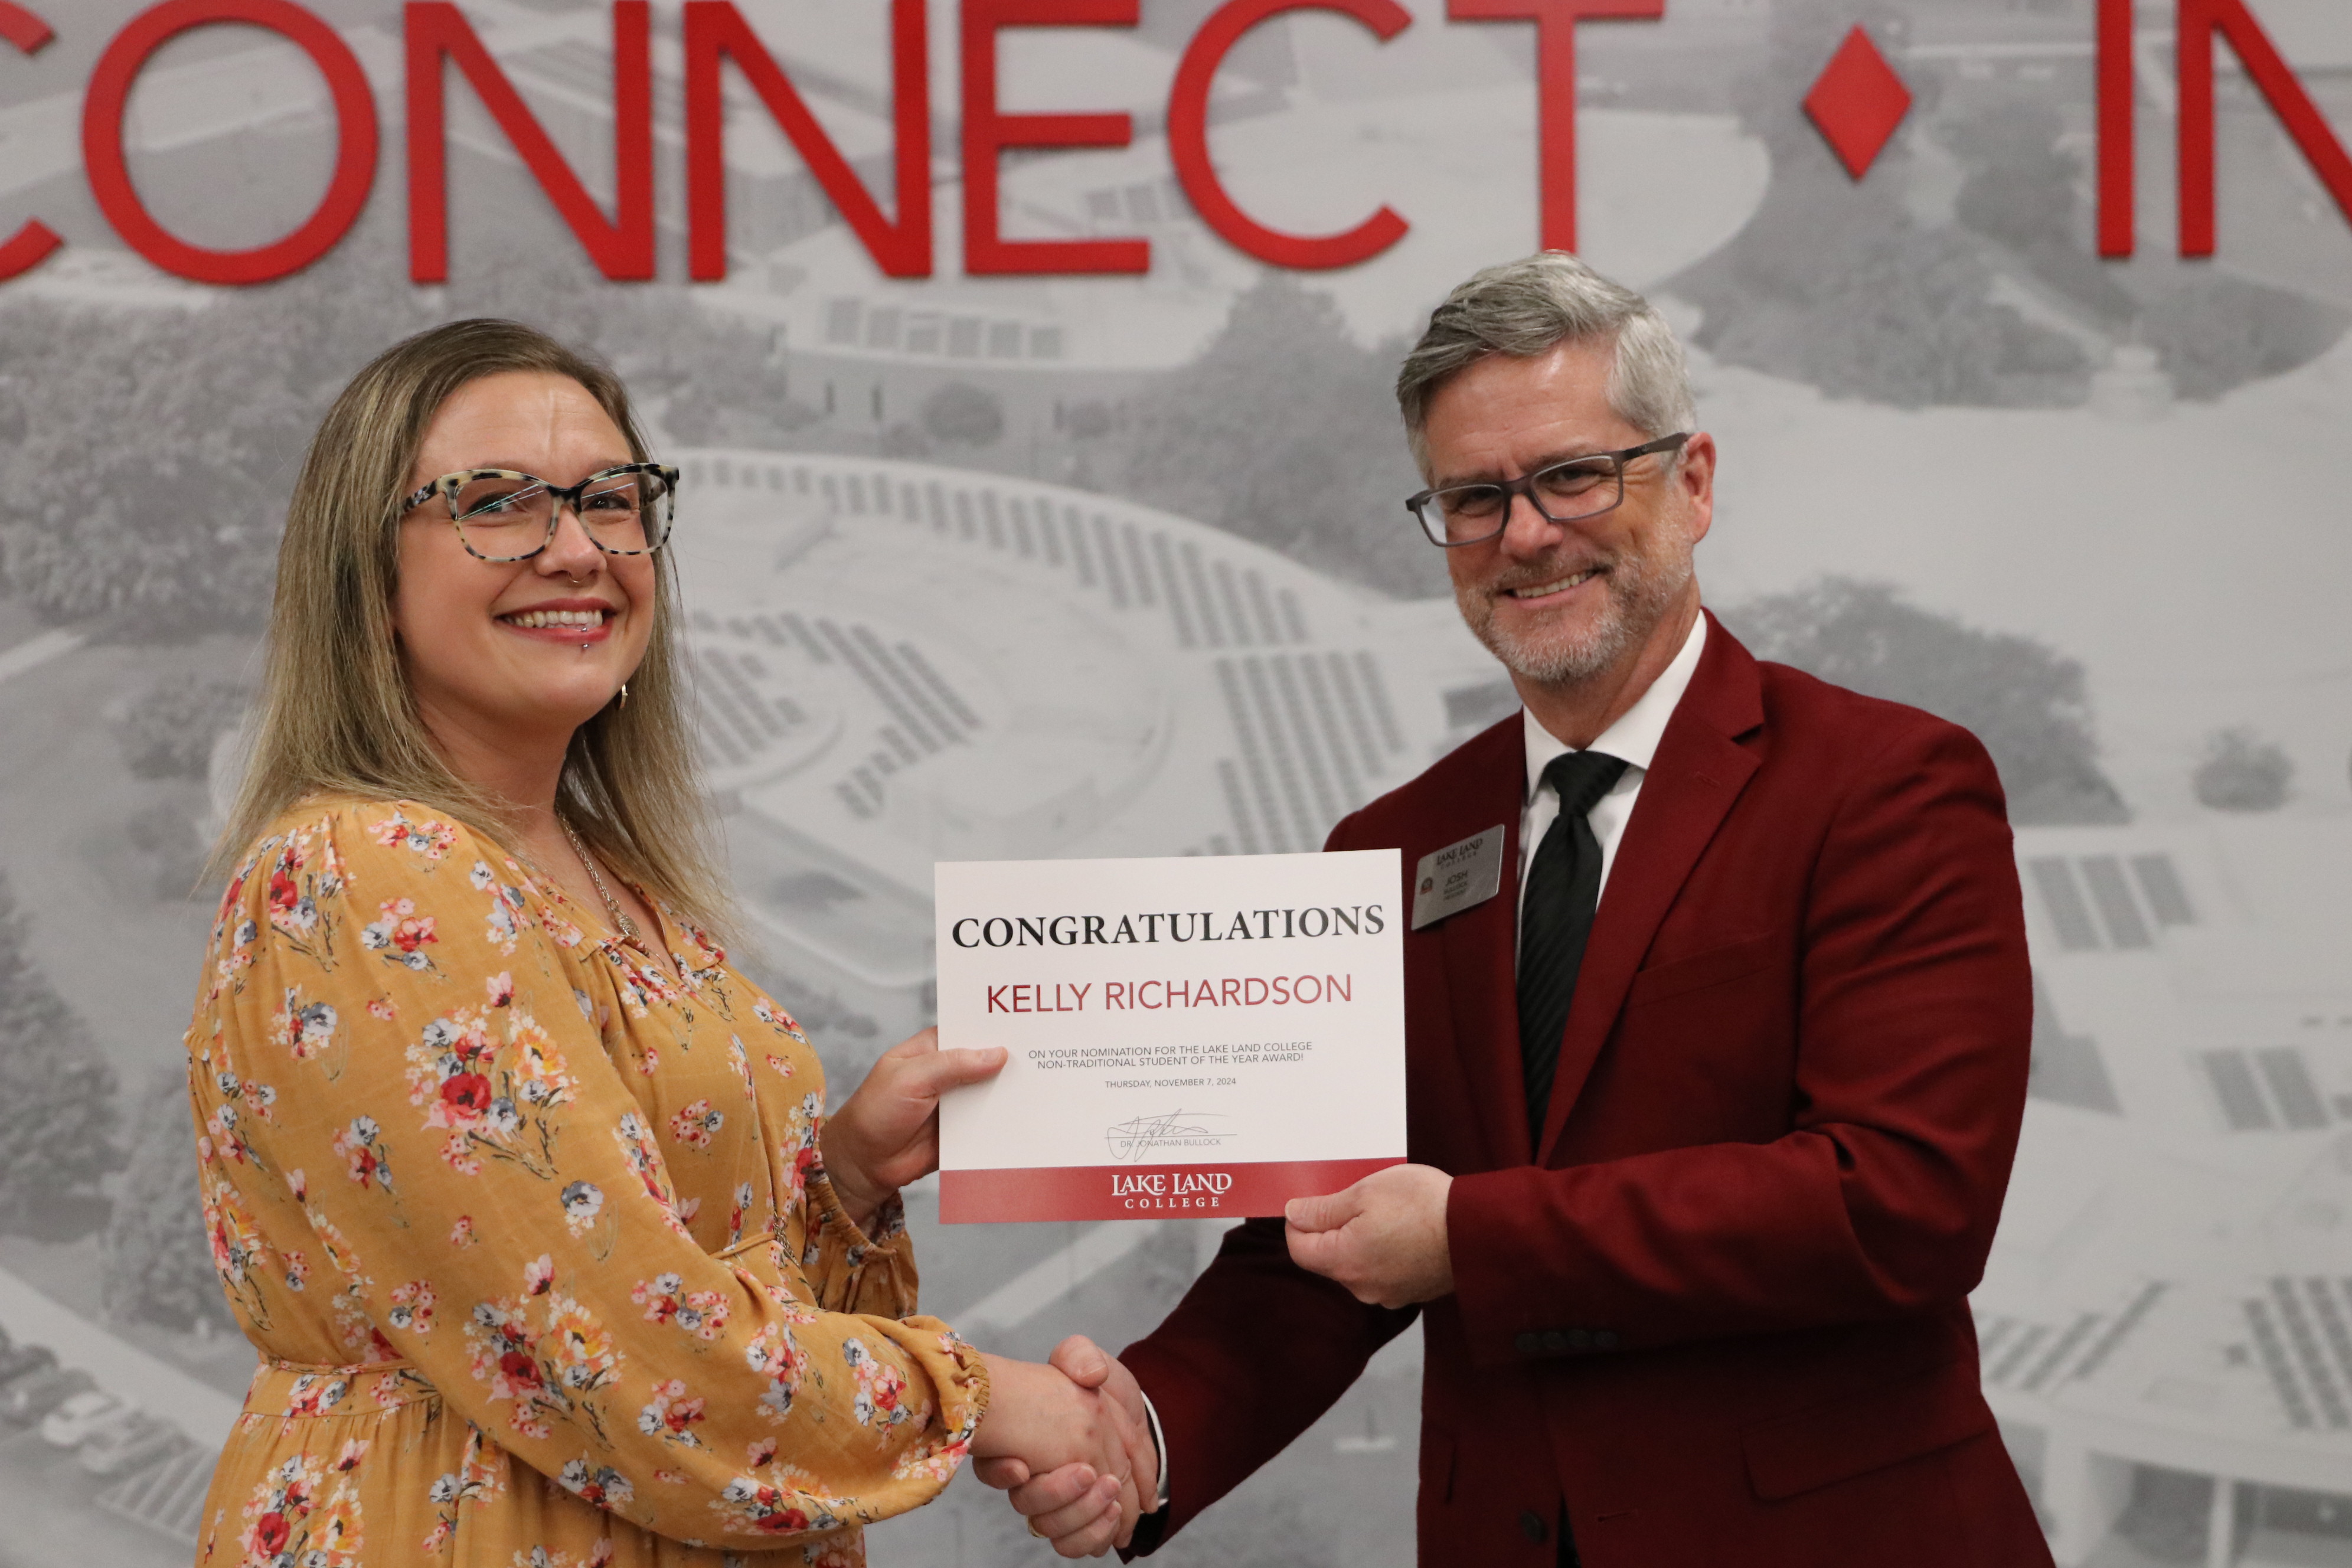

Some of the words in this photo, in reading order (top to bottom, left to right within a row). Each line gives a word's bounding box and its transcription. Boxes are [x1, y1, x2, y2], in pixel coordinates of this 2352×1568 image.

[0, 0, 1666, 285] ONNECT
[1436, 848, 1458, 866] LAKE
[1459, 837, 1484, 855] LAND
[1445, 869, 1468, 887] JOSH
[952, 904, 1385, 948] CONGRATULATIONS
[987, 982, 1092, 1014] KELLY
[1105, 974, 1351, 1010] RICHARDSON
[1028, 1050, 1046, 1059] ON
[1048, 1049, 1078, 1058] YOUR
[1081, 1047, 1151, 1057] NOMINATION
[1155, 1046, 1177, 1055] FOR
[1179, 1045, 1200, 1054] THE
[1203, 1044, 1229, 1054] LAKE
[1232, 1043, 1261, 1053] LAND
[1264, 1041, 1312, 1052] COLLEGE
[1038, 1058, 1136, 1069] NON-TRADITIONAL
[1139, 1056, 1188, 1066] STUDENT
[1191, 1056, 1206, 1064] OF
[1208, 1055, 1229, 1064] THE
[1231, 1054, 1259, 1063] YEAR
[1262, 1053, 1304, 1062] AWARD!
[1154, 1078, 1204, 1087] NOVEMBER
[1207, 1078, 1214, 1086] 7,
[1112, 1174, 1166, 1196] LAKE
[1172, 1172, 1233, 1194] LAND
[1125, 1197, 1219, 1208] COLLEGE
